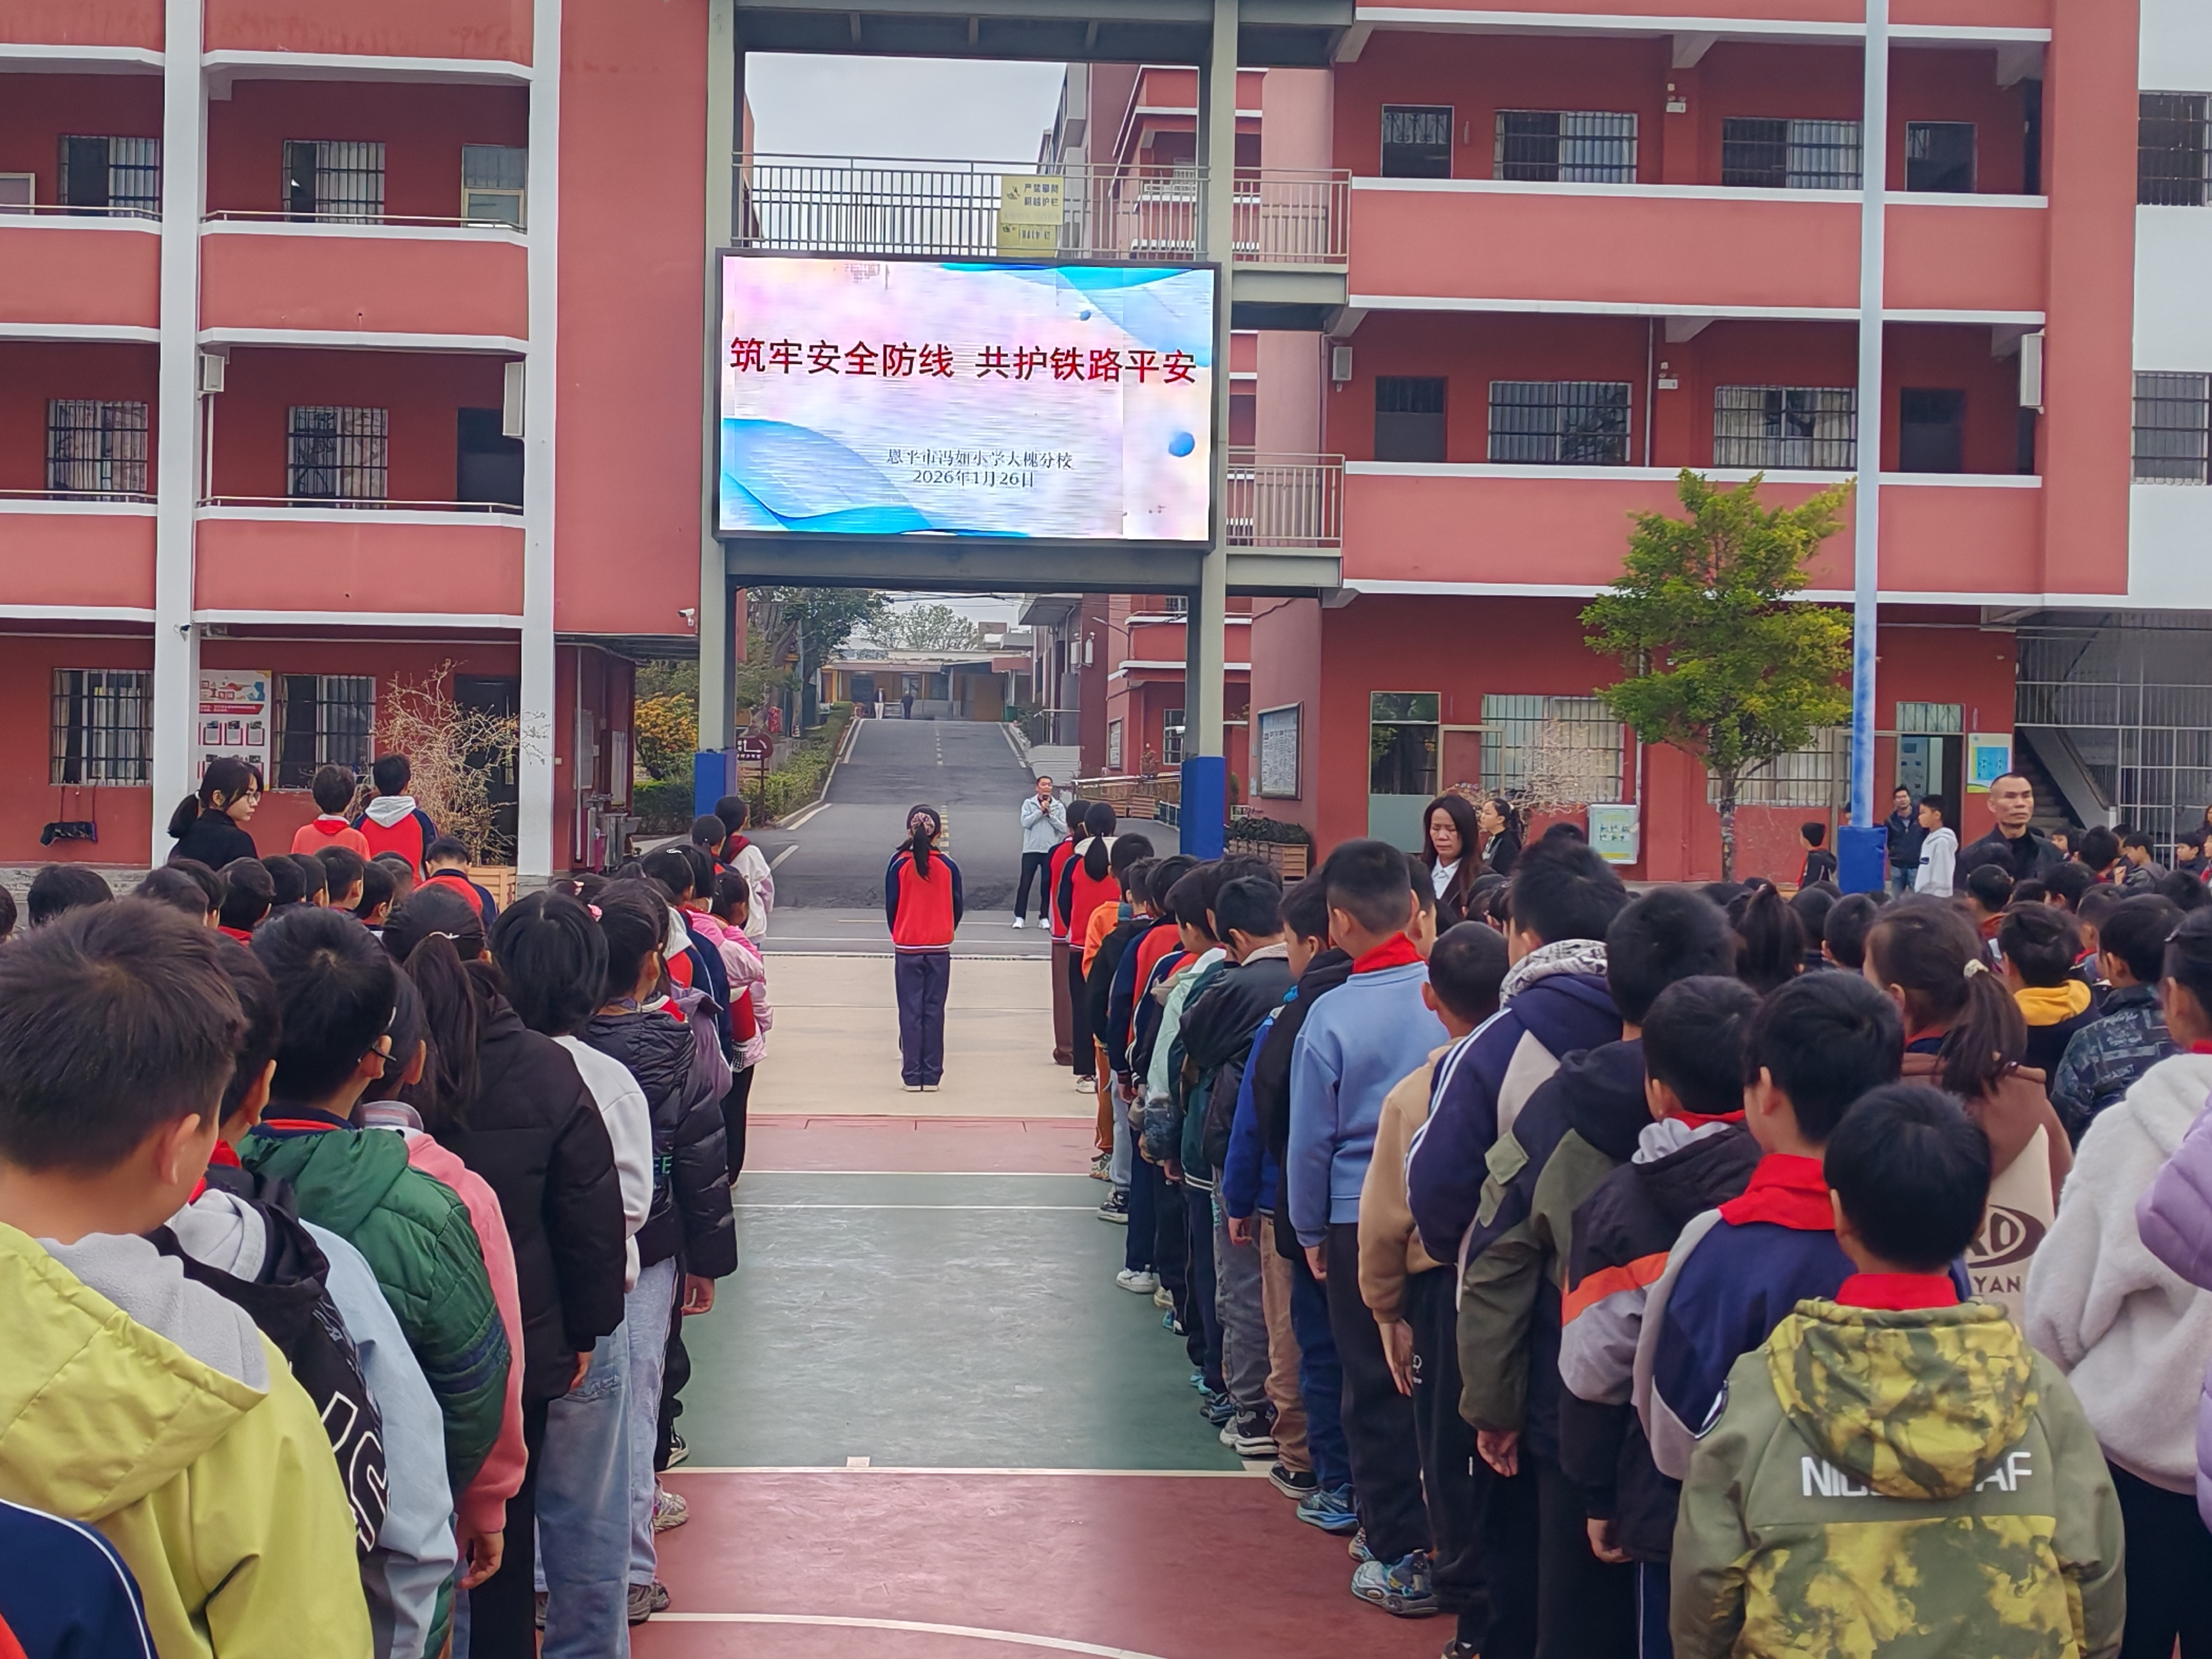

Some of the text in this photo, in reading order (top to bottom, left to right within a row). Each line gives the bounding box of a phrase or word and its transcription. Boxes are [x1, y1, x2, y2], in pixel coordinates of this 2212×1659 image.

[730, 336, 1197, 383] 筑牢安全防线 共护铁路平安
[886, 448, 1073, 469] 恩平市冯如小学大槐分校
[913, 470, 1034, 488] 2026年1月26日
[1973, 1276, 2021, 1293] YAN
